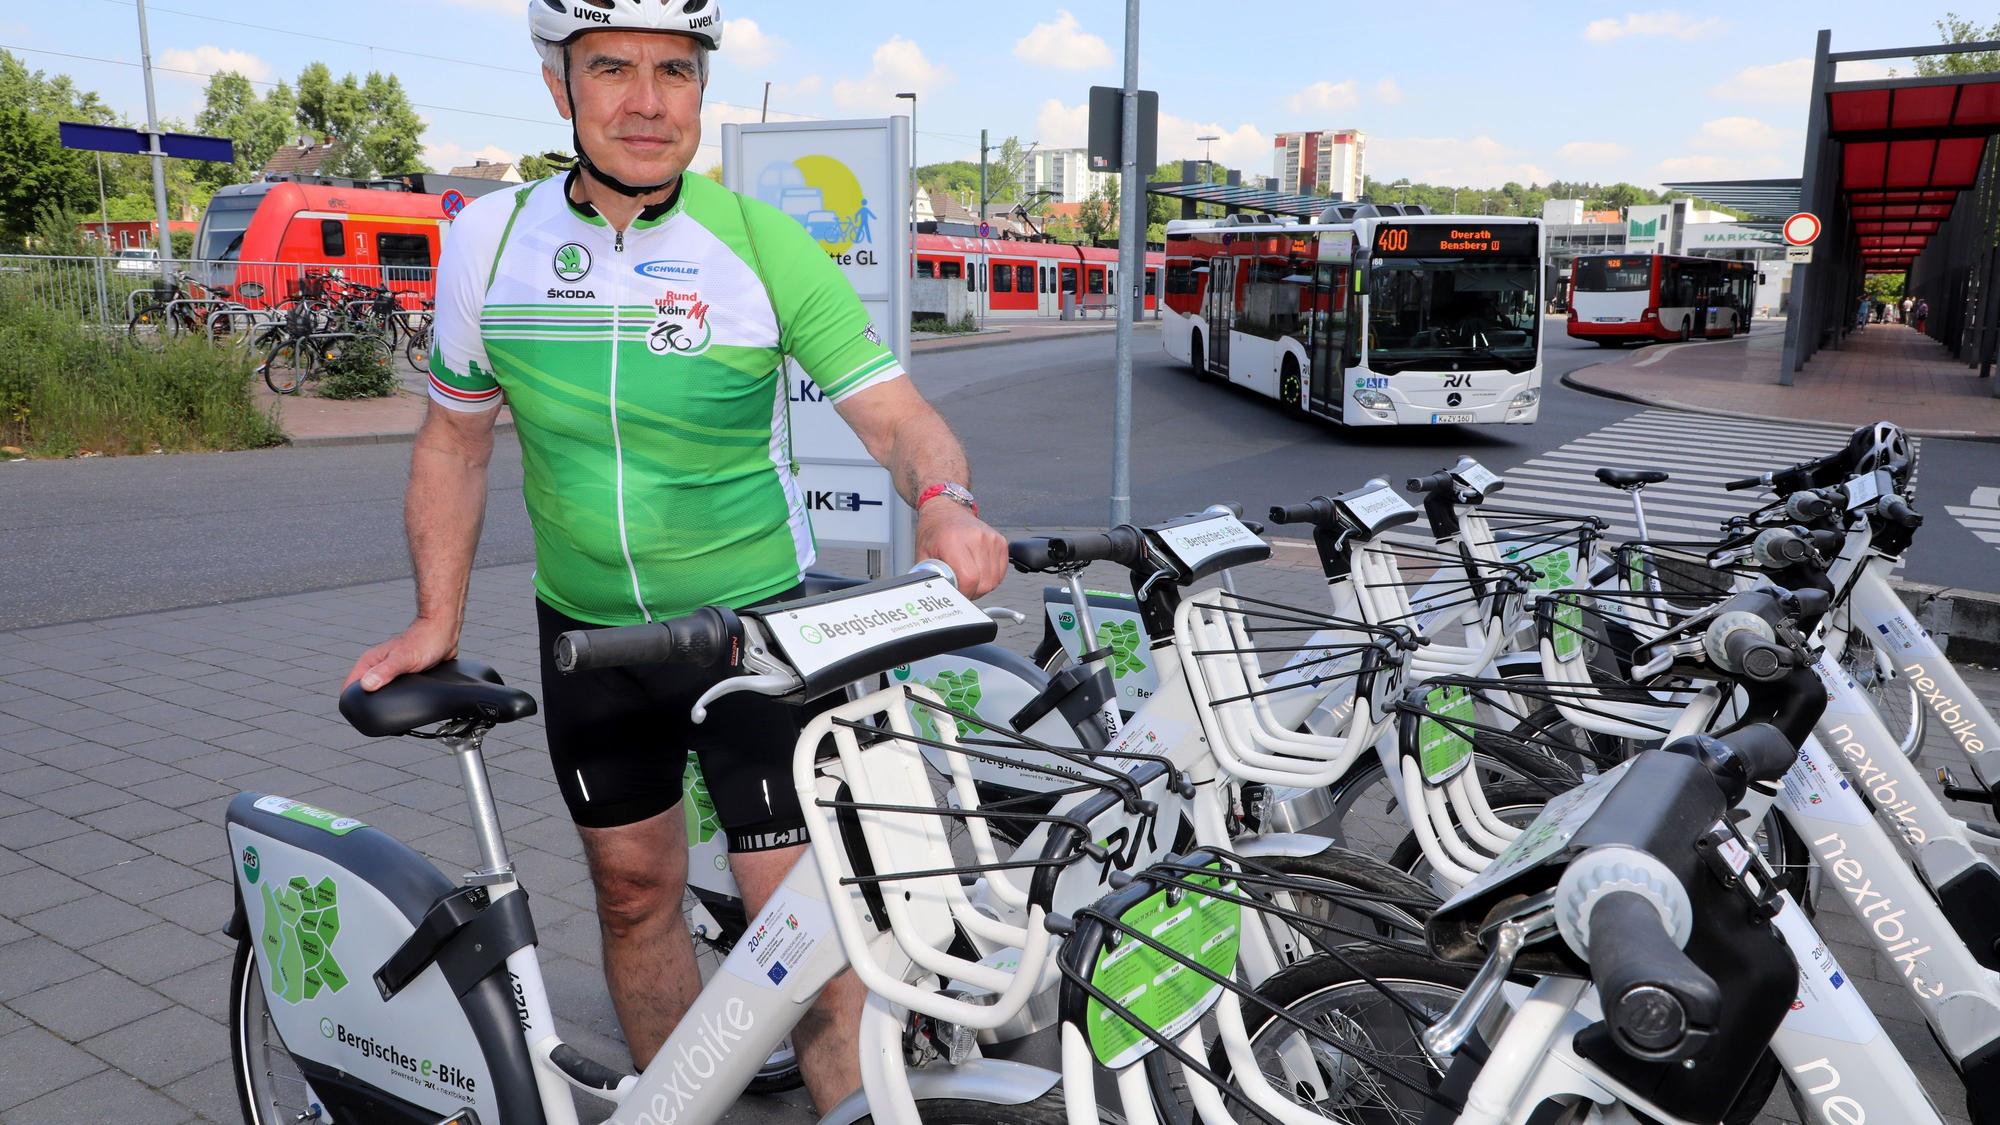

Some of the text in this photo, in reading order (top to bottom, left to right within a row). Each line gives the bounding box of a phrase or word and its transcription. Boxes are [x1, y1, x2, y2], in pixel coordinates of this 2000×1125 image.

[574, 6, 611, 25] uvex
[689, 15, 713, 30] uvex
[1378, 229, 1408, 251] 400
[1451, 230, 1491, 239] Overath
[1440, 241, 1487, 251] Bensberg
[856, 250, 878, 265] GL
[645, 265, 699, 275] SCHWALBE
[547, 288, 596, 299] ŠKODA
[666, 290, 697, 301] Rund
[655, 299, 674, 307] um
[658, 305, 686, 316] Köln
[807, 491, 853, 511] IKE
[818, 595, 954, 639] Bergisches e-Bike
[1058, 614, 1072, 622] VRS
[1904, 663, 1984, 754] nextbike
[1828, 724, 1926, 847] nextbike
[242, 849, 257, 868] VRS
[1813, 833, 1944, 999] nextbike
[337, 1024, 475, 1093] Bergisches e-Bike
[634, 997, 754, 1125] nextbike
[390, 1068, 414, 1082] powered
